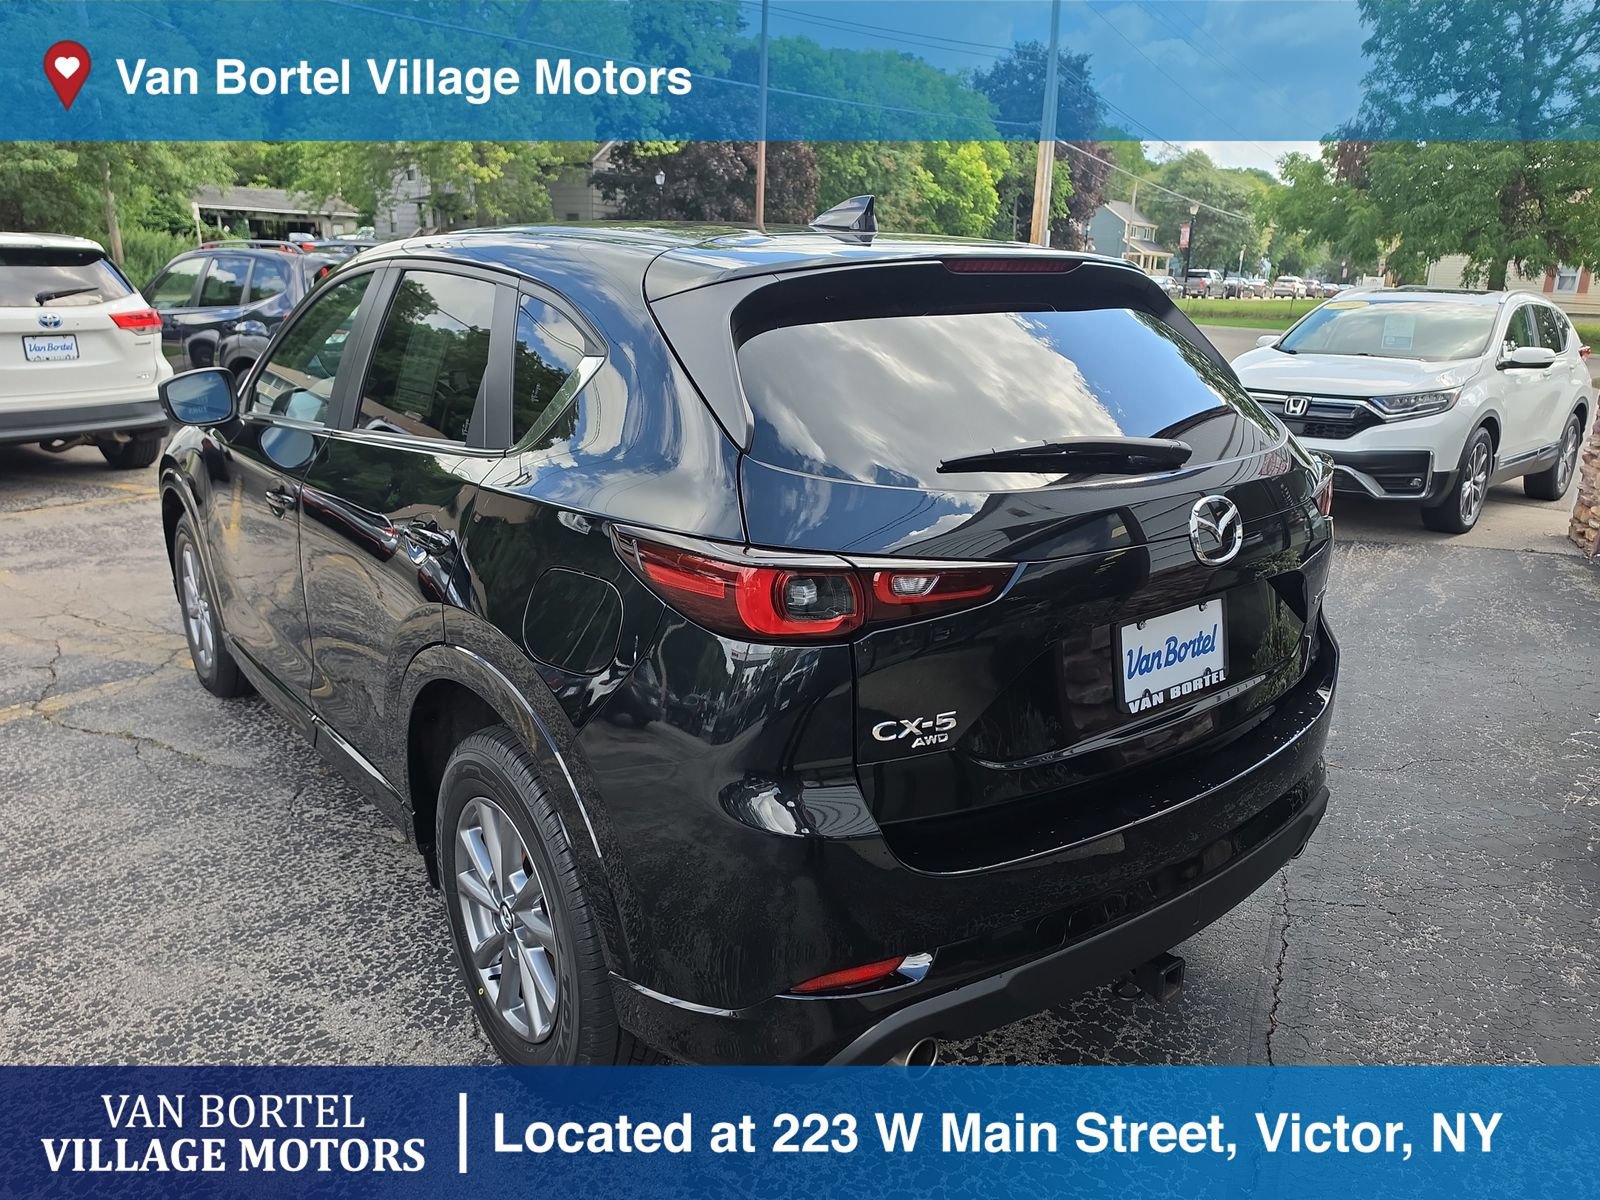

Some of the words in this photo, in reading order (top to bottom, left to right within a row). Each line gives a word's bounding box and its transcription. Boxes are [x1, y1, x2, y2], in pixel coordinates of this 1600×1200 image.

[29, 343, 46, 352] Van
[1126, 645, 1162, 680] Van
[1163, 623, 1218, 668] Bortel
[1128, 691, 1164, 714] VAN
[1170, 669, 1226, 700] BORTEL
[872, 710, 957, 741] CX-5
[911, 733, 949, 749] AWD
